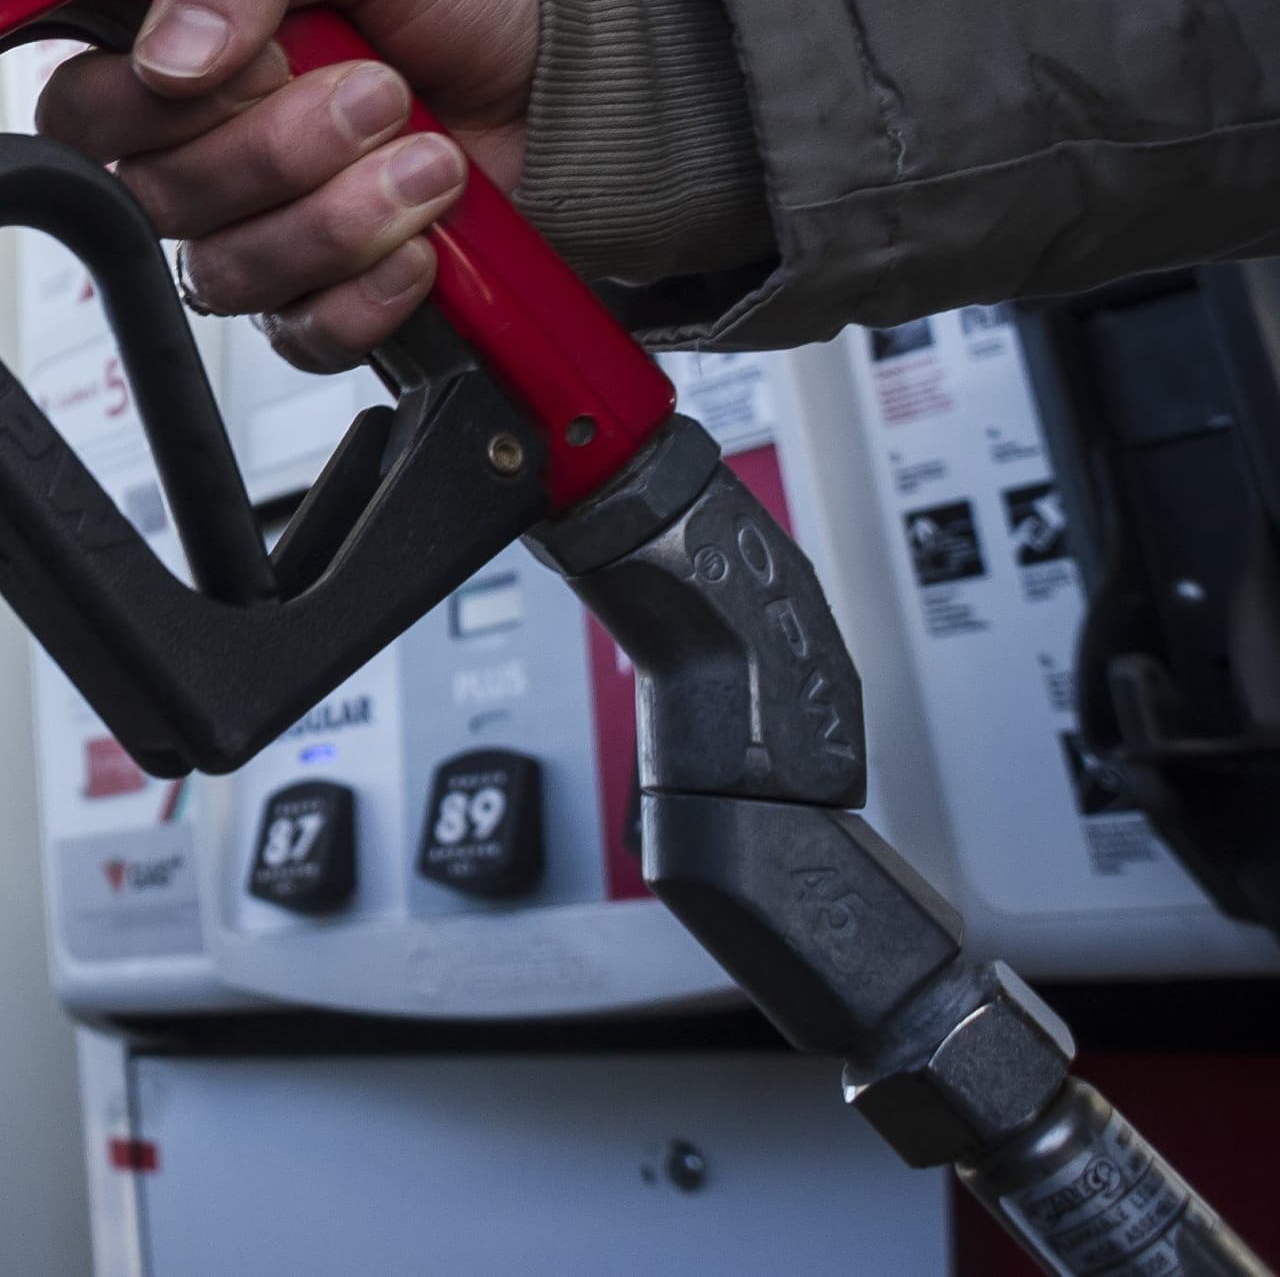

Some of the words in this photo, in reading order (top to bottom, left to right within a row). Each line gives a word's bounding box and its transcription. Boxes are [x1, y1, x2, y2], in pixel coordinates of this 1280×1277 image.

[736, 521, 858, 762] OPW
[263, 812, 324, 866] 87
[433, 787, 507, 844] 89
